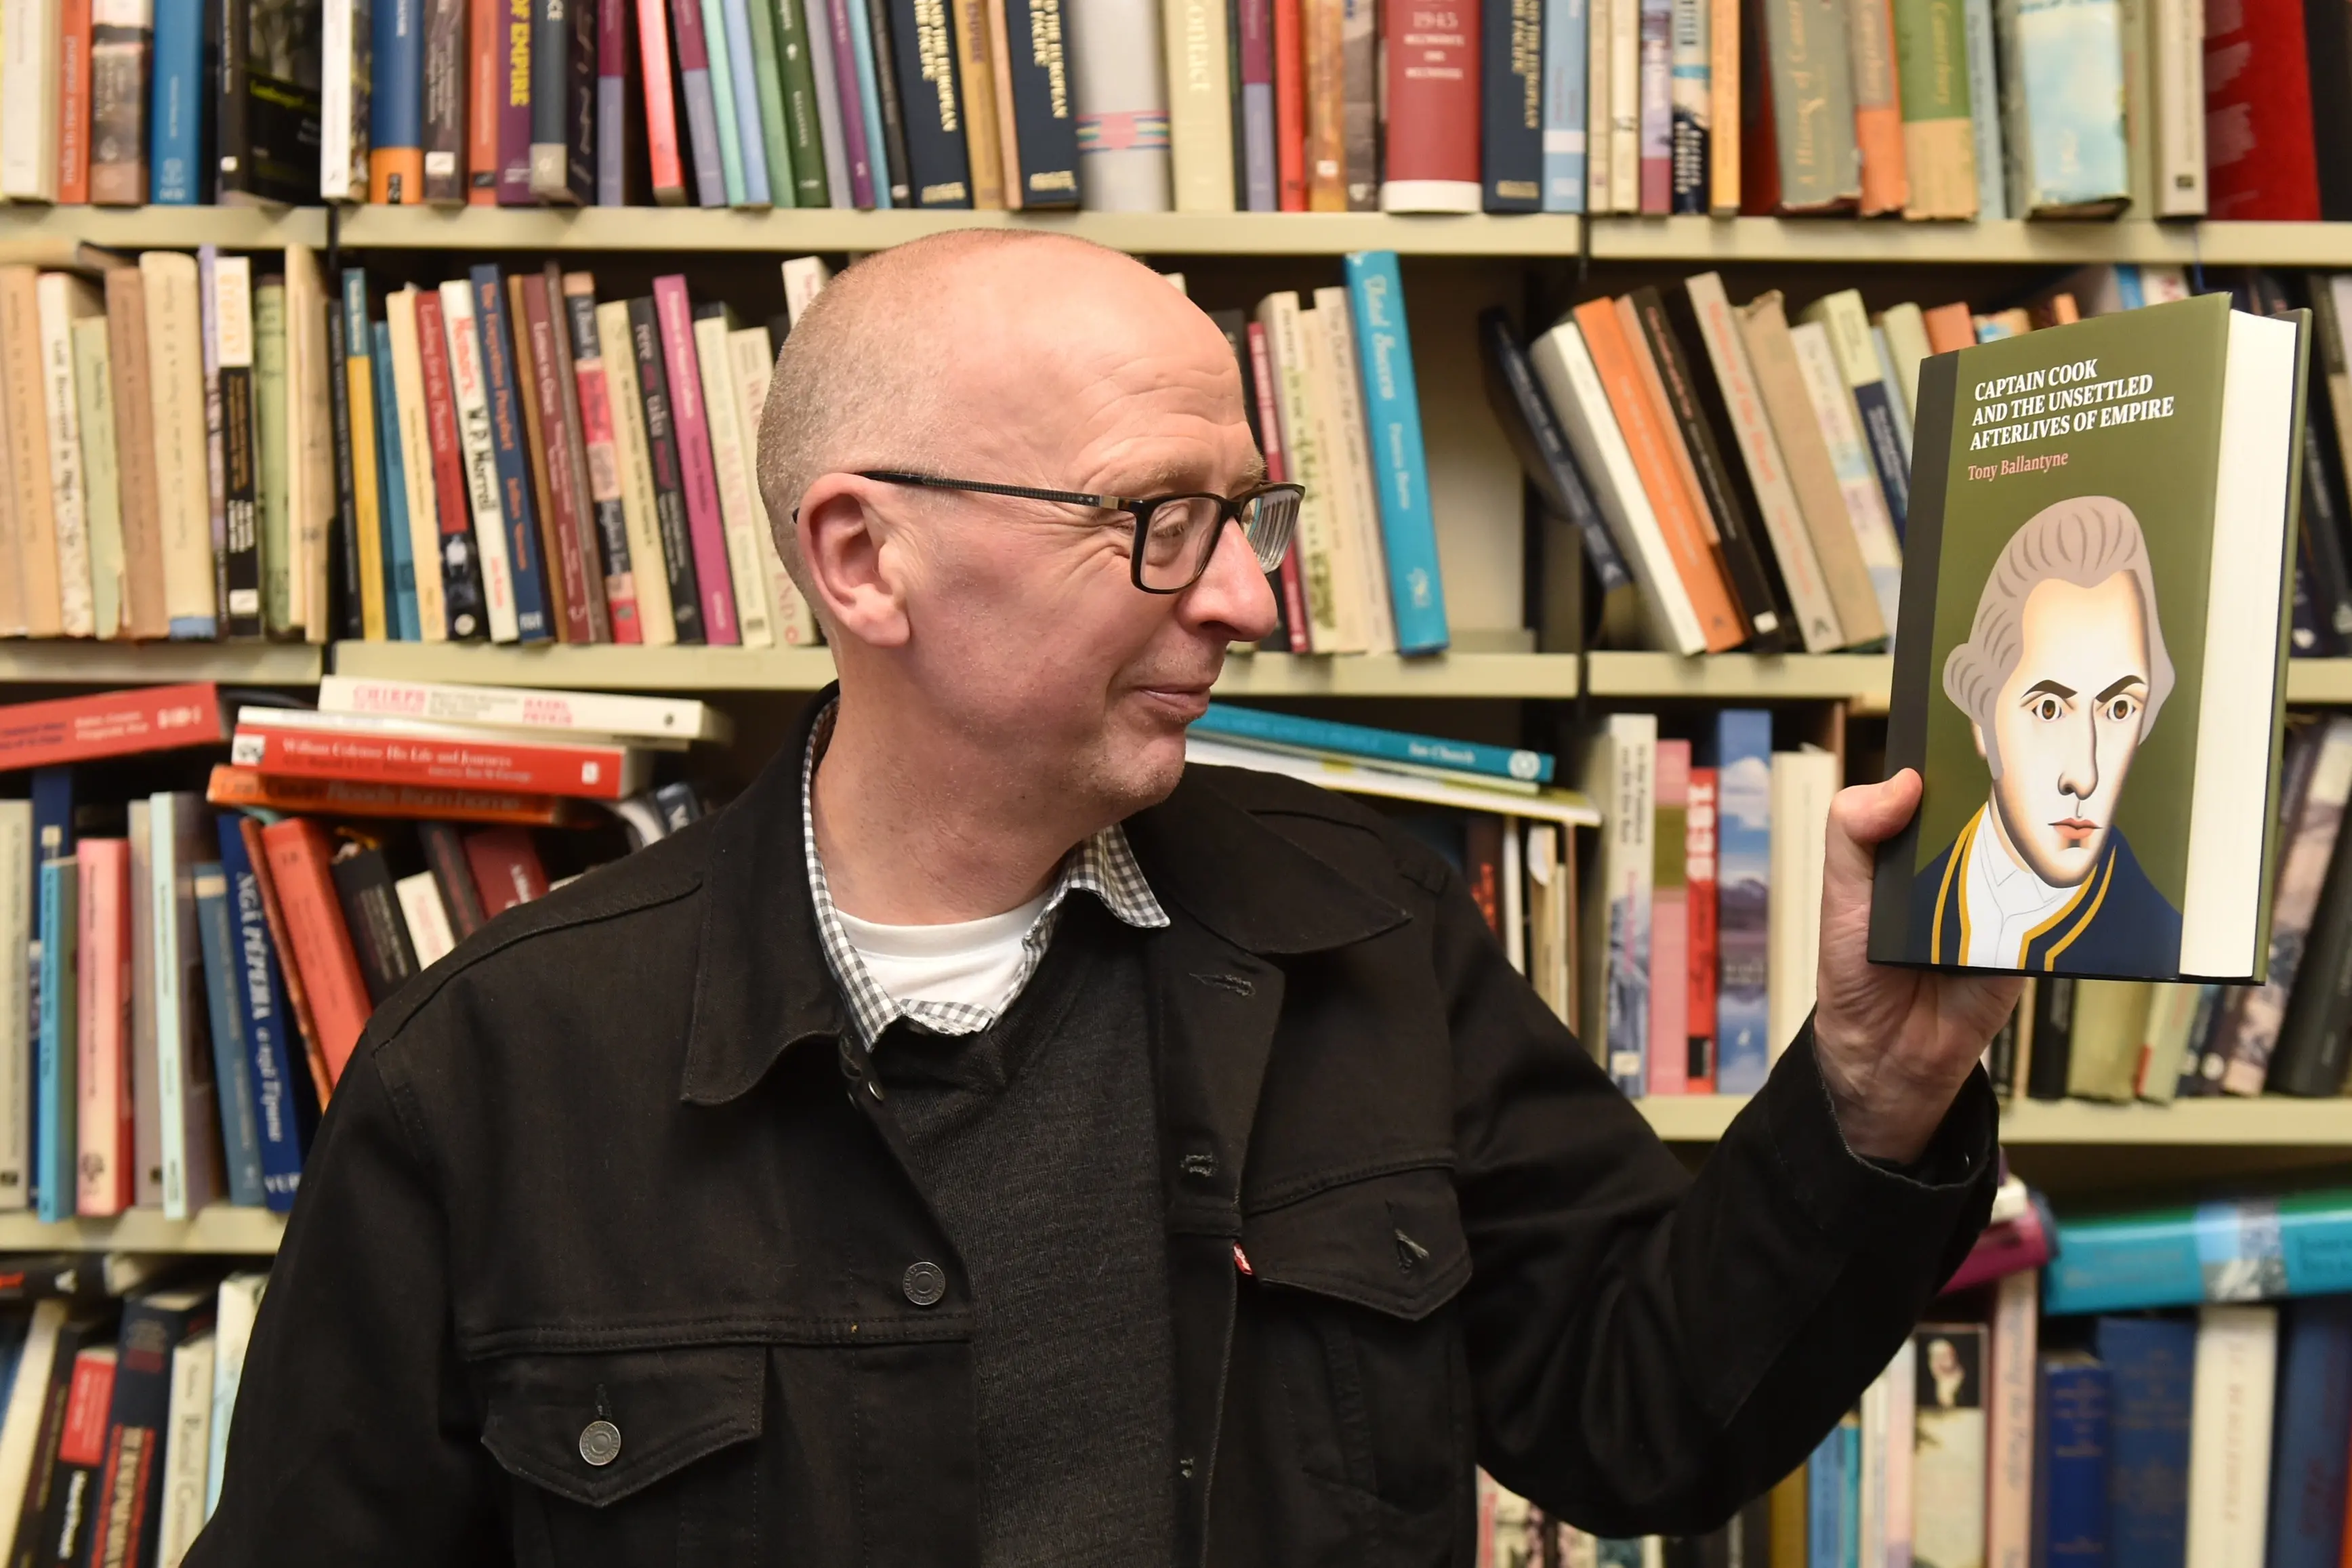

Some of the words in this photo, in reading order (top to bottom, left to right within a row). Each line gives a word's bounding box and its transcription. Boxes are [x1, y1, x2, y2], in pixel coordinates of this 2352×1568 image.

[917, 26, 936, 81] PACIFIC
[932, 26, 949, 57] THE
[1030, 11, 1050, 67] PACIFIC
[1046, 12, 1062, 43] THE
[1185, 0, 1211, 93] ontact
[1511, 19, 1526, 76] PACIFIC
[511, 22, 531, 107] EMPIRE
[1048, 43, 1069, 119] EUROPEAN
[1525, 53, 1540, 129] EUROPEAN
[934, 56, 957, 132] EUROPEAN
[1972, 403, 2008, 426] AND
[2010, 394, 2045, 419] THE
[2048, 374, 2153, 411] UNSETTLED
[1975, 369, 2045, 401] CAPTAIN
[2048, 358, 2098, 386] COOK
[1970, 417, 2070, 451] AFTERLIVES
[2074, 410, 2098, 432] OF
[2100, 396, 2174, 428] EMPIRE
[1968, 462, 1998, 482] Tony
[2000, 451, 2069, 476] Ballantyne
